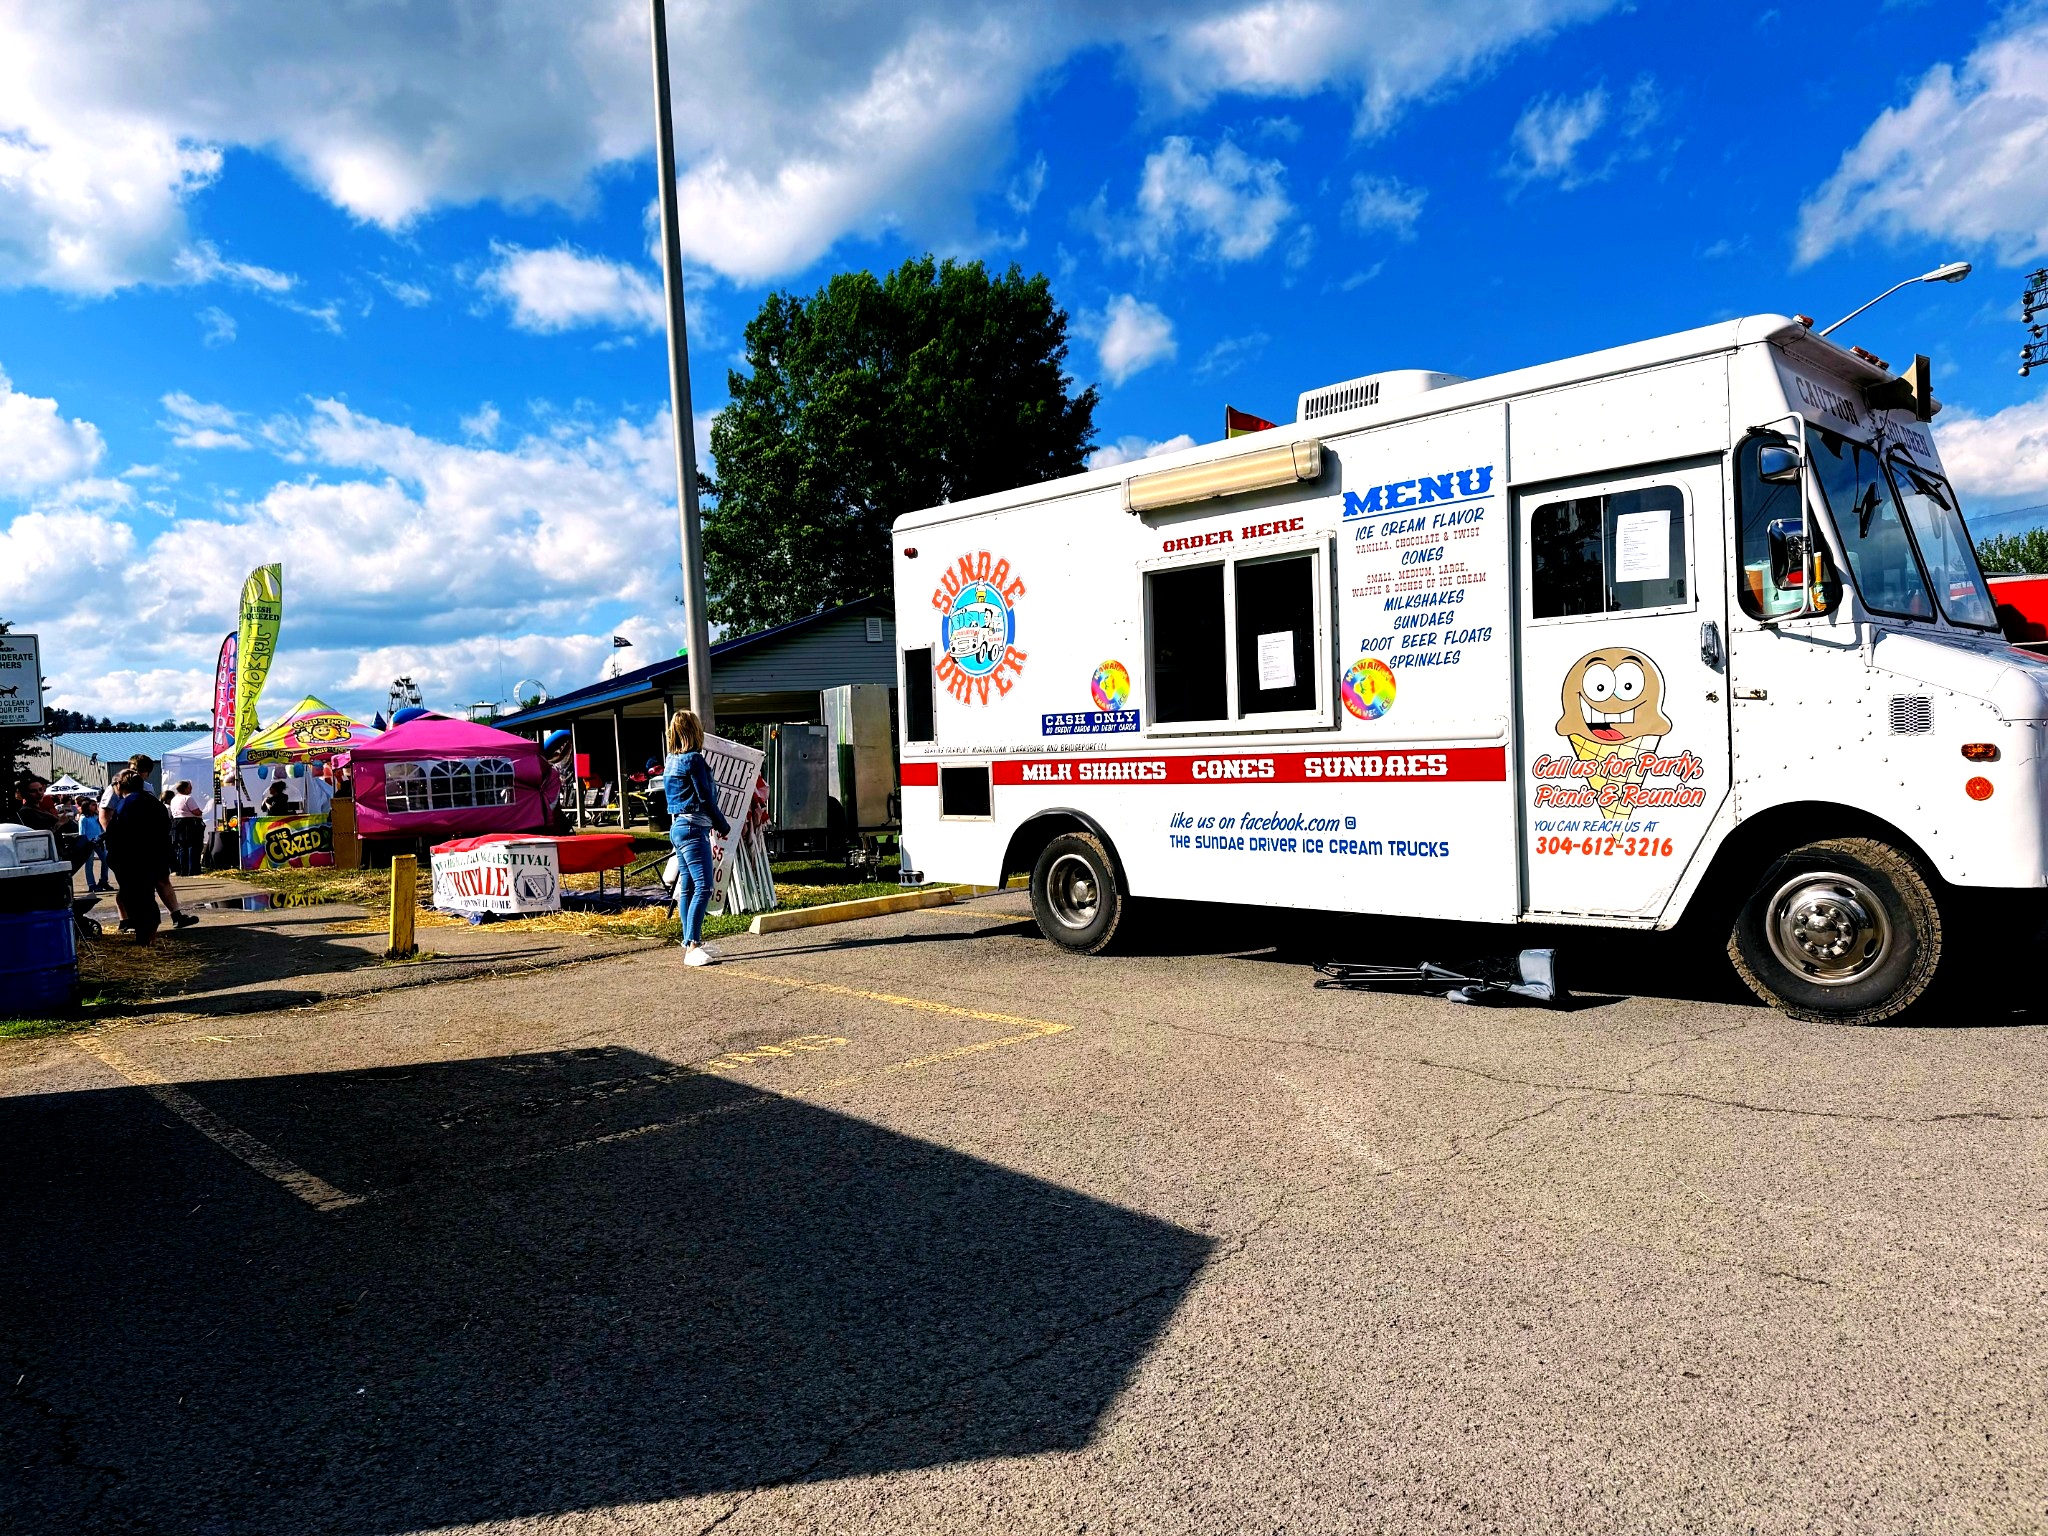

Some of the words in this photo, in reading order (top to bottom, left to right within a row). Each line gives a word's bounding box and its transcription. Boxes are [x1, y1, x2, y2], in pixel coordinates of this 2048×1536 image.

[1796, 376, 1860, 427] CAUTION
[1343, 465, 1494, 517] MENU
[1163, 530, 1234, 553] ORDER
[1242, 517, 1304, 540] HERE
[1355, 525, 1375, 541] ICE
[1381, 517, 1427, 537] CREAM
[1433, 507, 1485, 529] FLAVOR
[1395, 533, 1440, 549] CHOCOLATE
[1444, 532, 1449, 541] &
[1453, 527, 1480, 540] TWIST
[1401, 546, 1444, 565] CONES
[932, 551, 1027, 615] SUNDAE
[1352, 585, 1382, 597] WAFFLE
[1386, 585, 1391, 593] &
[1395, 580, 1423, 592] DISHES
[1426, 578, 1436, 589] OF
[1440, 576, 1453, 587] ICE
[1456, 572, 1487, 585] CREAM
[1384, 589, 1465, 611] MILKSHAKES
[1394, 610, 1455, 630] SUNDAES
[1361, 636, 1395, 652] ROOT
[1401, 632, 1437, 648] BEER
[1444, 627, 1493, 645] FLOATS
[1389, 650, 1461, 669] SPRINKLES
[935, 645, 1028, 705] DRIVER
[1045, 714, 1086, 726] CASH
[1094, 711, 1136, 724] ONLY
[1092, 725, 1099, 733] NO
[1022, 762, 1073, 780] MILK
[1078, 761, 1167, 780] SHAKES
[1192, 759, 1275, 779] CONES
[1304, 755, 1448, 778] SUNDAES
[1534, 756, 1571, 777] Call
[1572, 760, 1597, 777] us
[1602, 753, 1635, 777] for
[1637, 751, 1703, 782] Party,
[1535, 784, 1596, 807] Picnic
[1601, 784, 1619, 806] &
[1622, 784, 1705, 807] Reunion
[1170, 812, 1194, 828] like
[1198, 817, 1216, 829] us
[1218, 816, 1236, 830] on
[1240, 811, 1340, 832] facebook.com
[1534, 821, 1556, 832] YOU
[1557, 821, 1580, 832] CAN
[1583, 821, 1622, 832] REACH
[1625, 822, 1640, 832] US
[1644, 822, 1659, 832] AT
[269, 831, 288, 841] THE
[269, 831, 321, 860] CRAZED
[1536, 836, 1673, 857] 304-612-3216
[1388, 840, 1450, 857] TRUCKS
